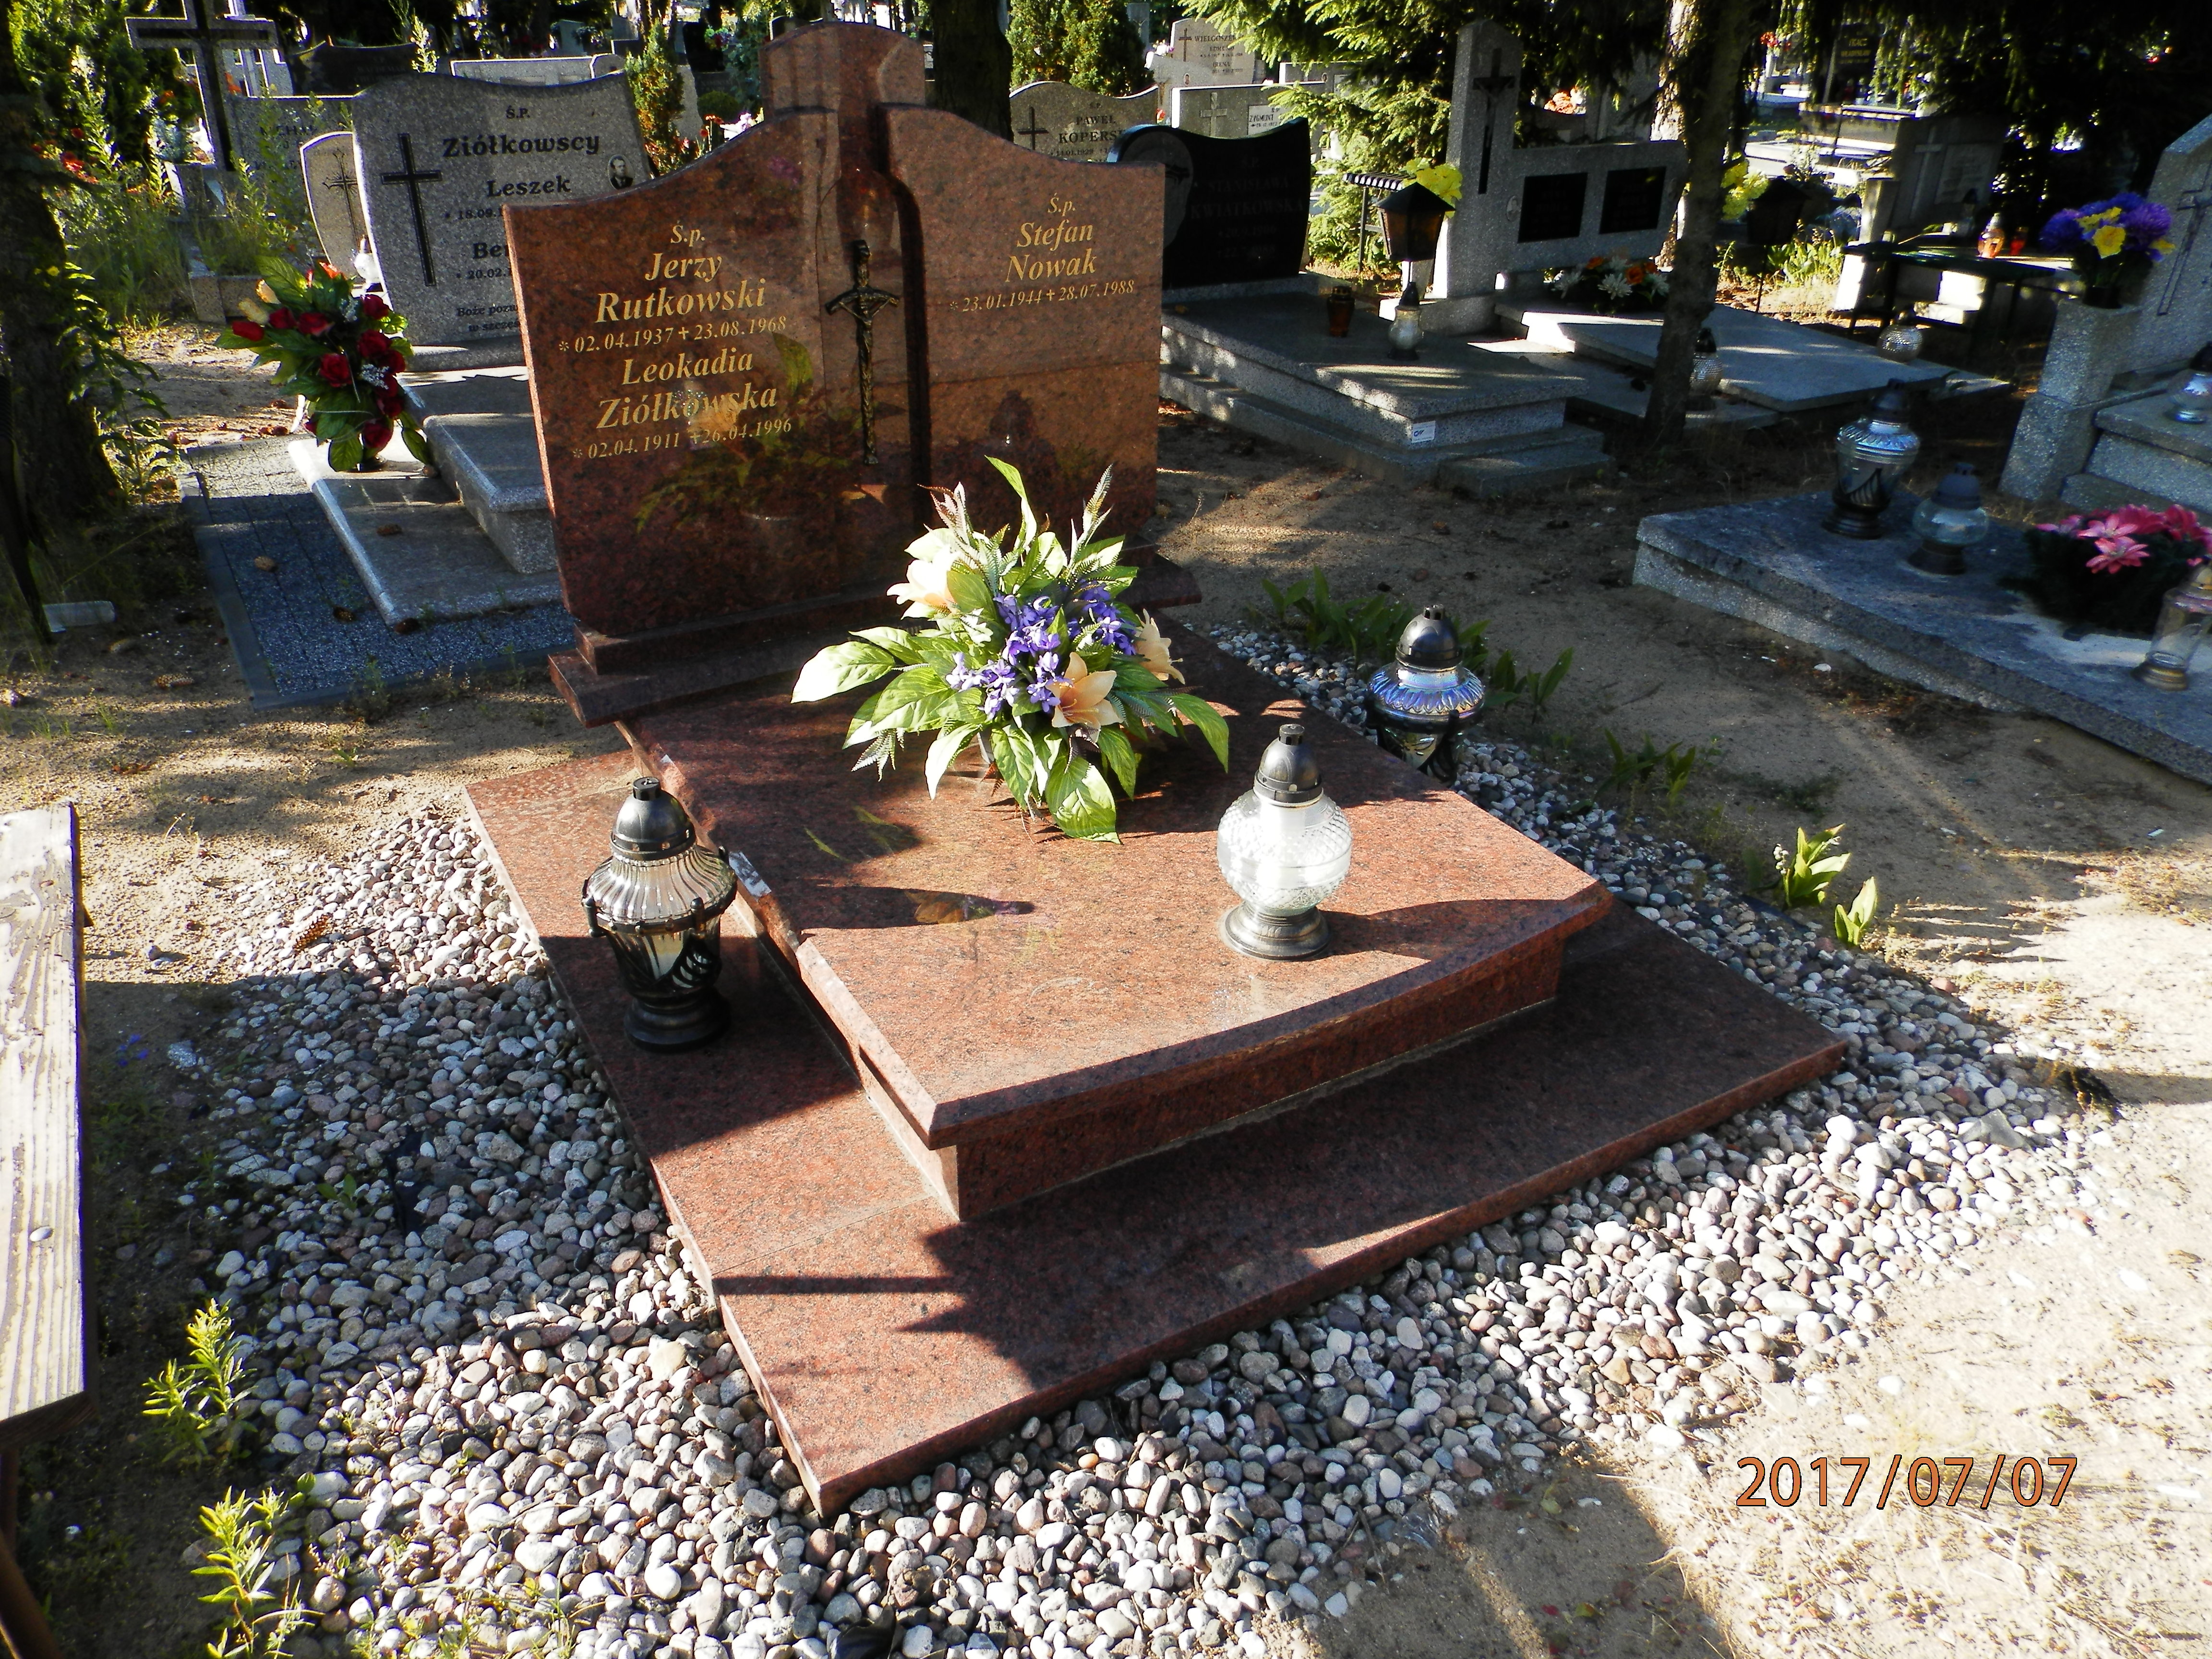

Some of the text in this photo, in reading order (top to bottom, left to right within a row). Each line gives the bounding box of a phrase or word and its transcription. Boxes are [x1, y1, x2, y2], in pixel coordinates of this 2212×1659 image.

[443, 134, 600, 157] Ziółkowscy
[487, 175, 571, 198] Leszek
[1047, 192, 1076, 217] Ś.p.
[1190, 197, 1304, 219] KWIATKOWSKA
[670, 220, 706, 247] Ś.p.
[1016, 219, 1094, 252] Stefan
[645, 252, 722, 283] Jerzy
[1005, 248, 1097, 282] Nowak
[594, 278, 766, 324] Rutkowski
[622, 347, 754, 385] Leokadia
[596, 382, 778, 429] Ziółkowska
